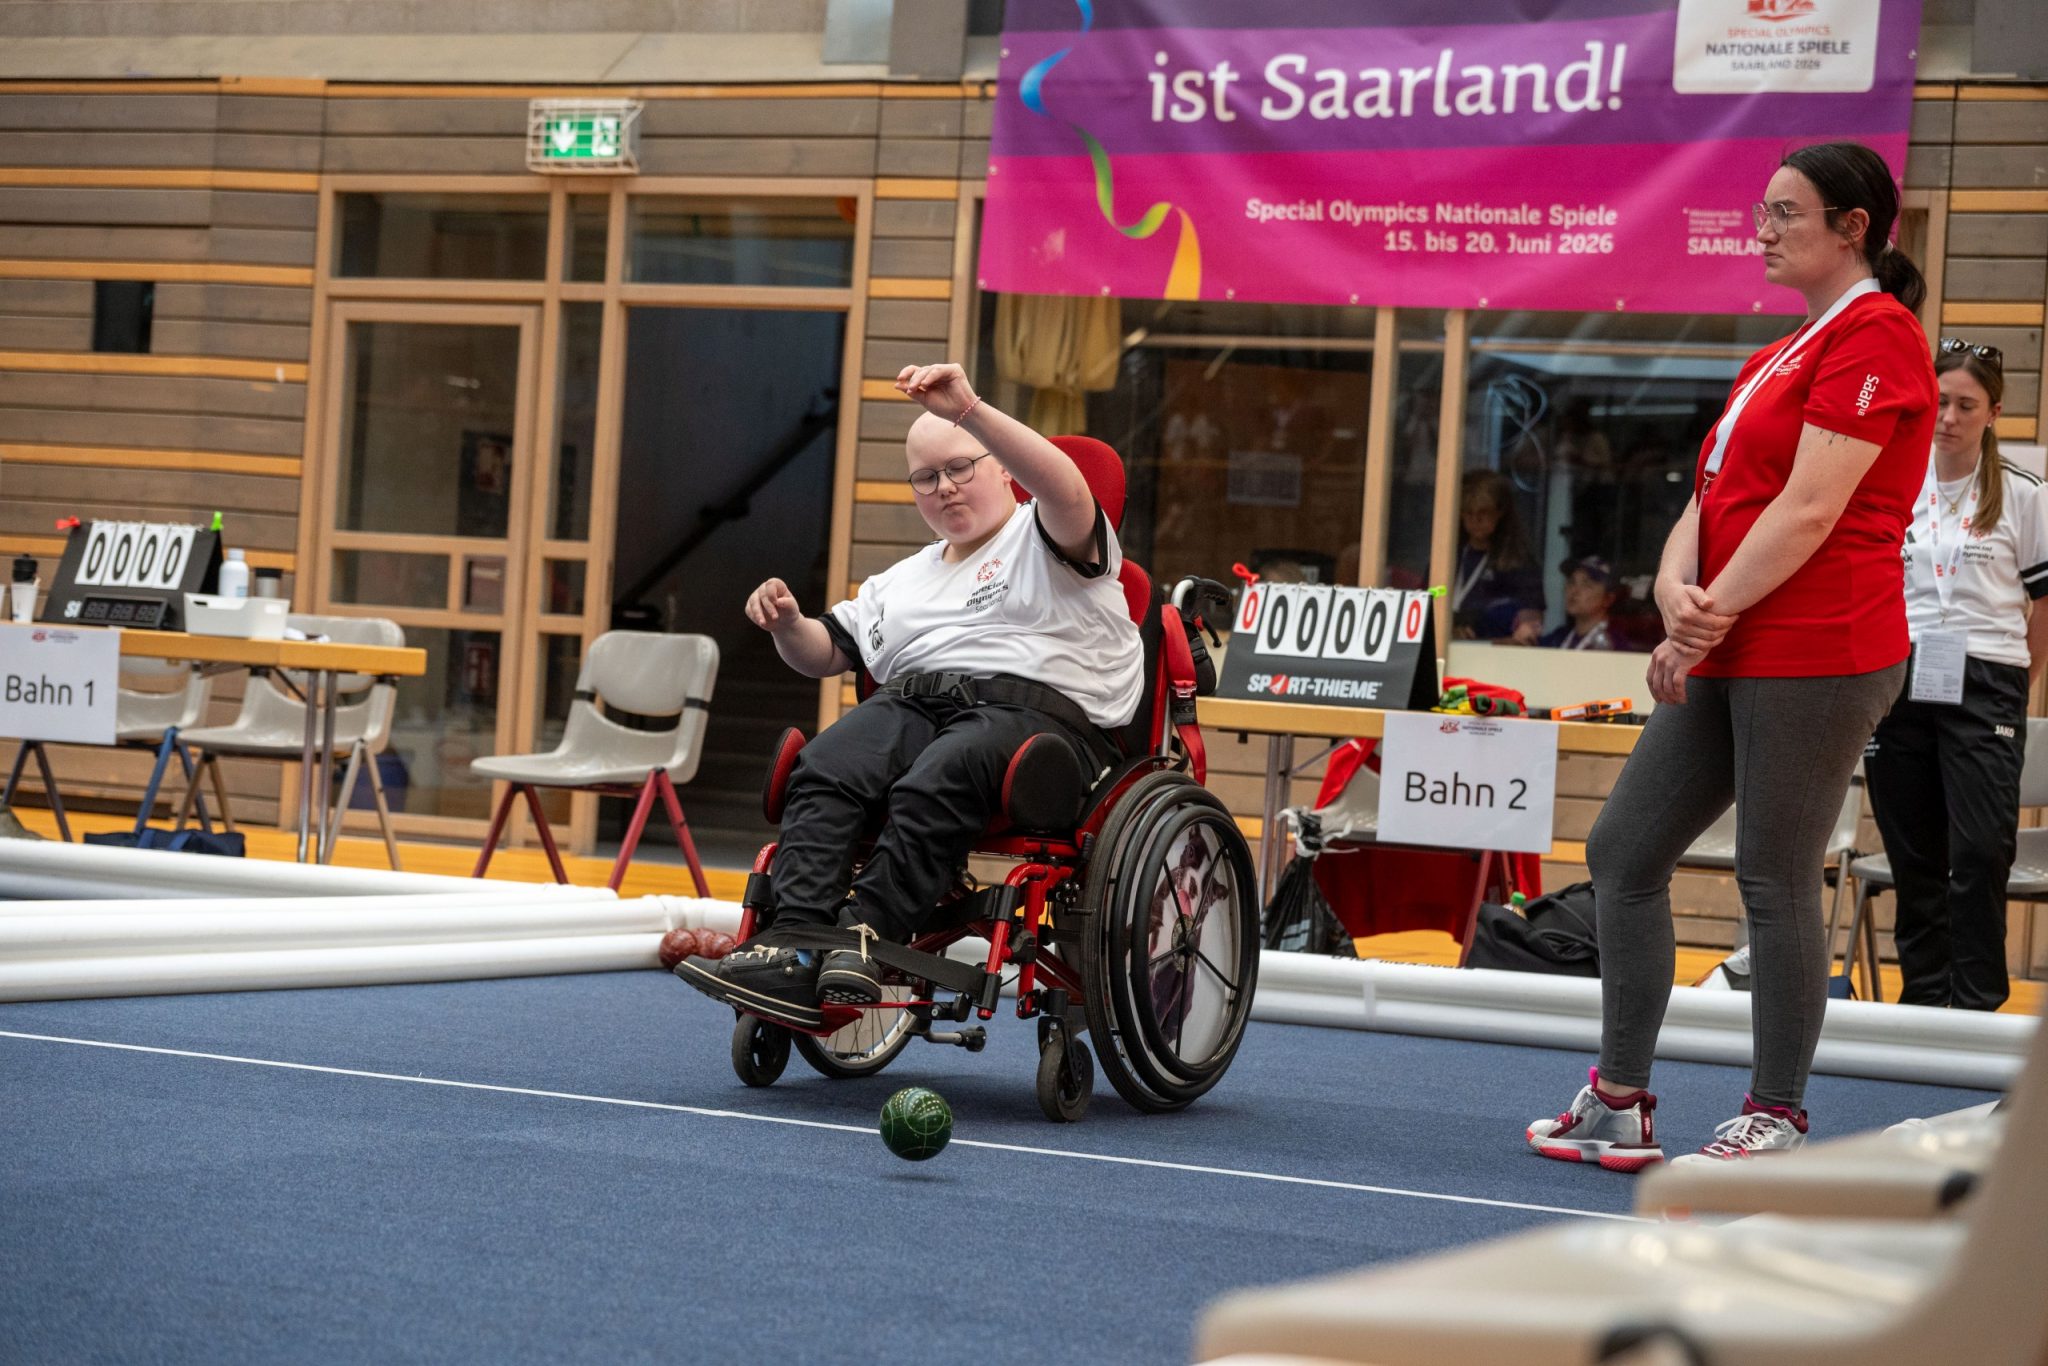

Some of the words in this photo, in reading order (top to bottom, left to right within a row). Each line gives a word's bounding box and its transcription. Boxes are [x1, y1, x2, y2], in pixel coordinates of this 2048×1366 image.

[1728, 26, 1772, 39] SPECIAL
[1776, 24, 1832, 38] OLYMPICS
[1705, 42, 1793, 57] NATIONALE
[1797, 40, 1852, 55] SPIELE
[1731, 60, 1792, 71] SAARLAND
[1794, 59, 1820, 70] 2026
[1148, 51, 1240, 122] ist
[1260, 38, 1628, 121] Saarland!
[1245, 198, 1325, 223] Special
[1329, 199, 1430, 227] Olympics
[1435, 202, 1542, 226] Nationale
[1548, 203, 1618, 231] Spiele
[1384, 230, 1418, 252] 15.
[1425, 230, 1459, 253] bis
[1465, 231, 1499, 254] 20.
[1506, 232, 1552, 254] Juni
[1557, 232, 1615, 255] 2026
[1687, 236, 1767, 256] SAARLAN
[6, 674, 73, 706] Bahn
[84, 679, 95, 707] 1
[1994, 724, 2015, 738] JAKO
[1405, 771, 1495, 809] Bahn
[1508, 778, 1528, 810] 2
